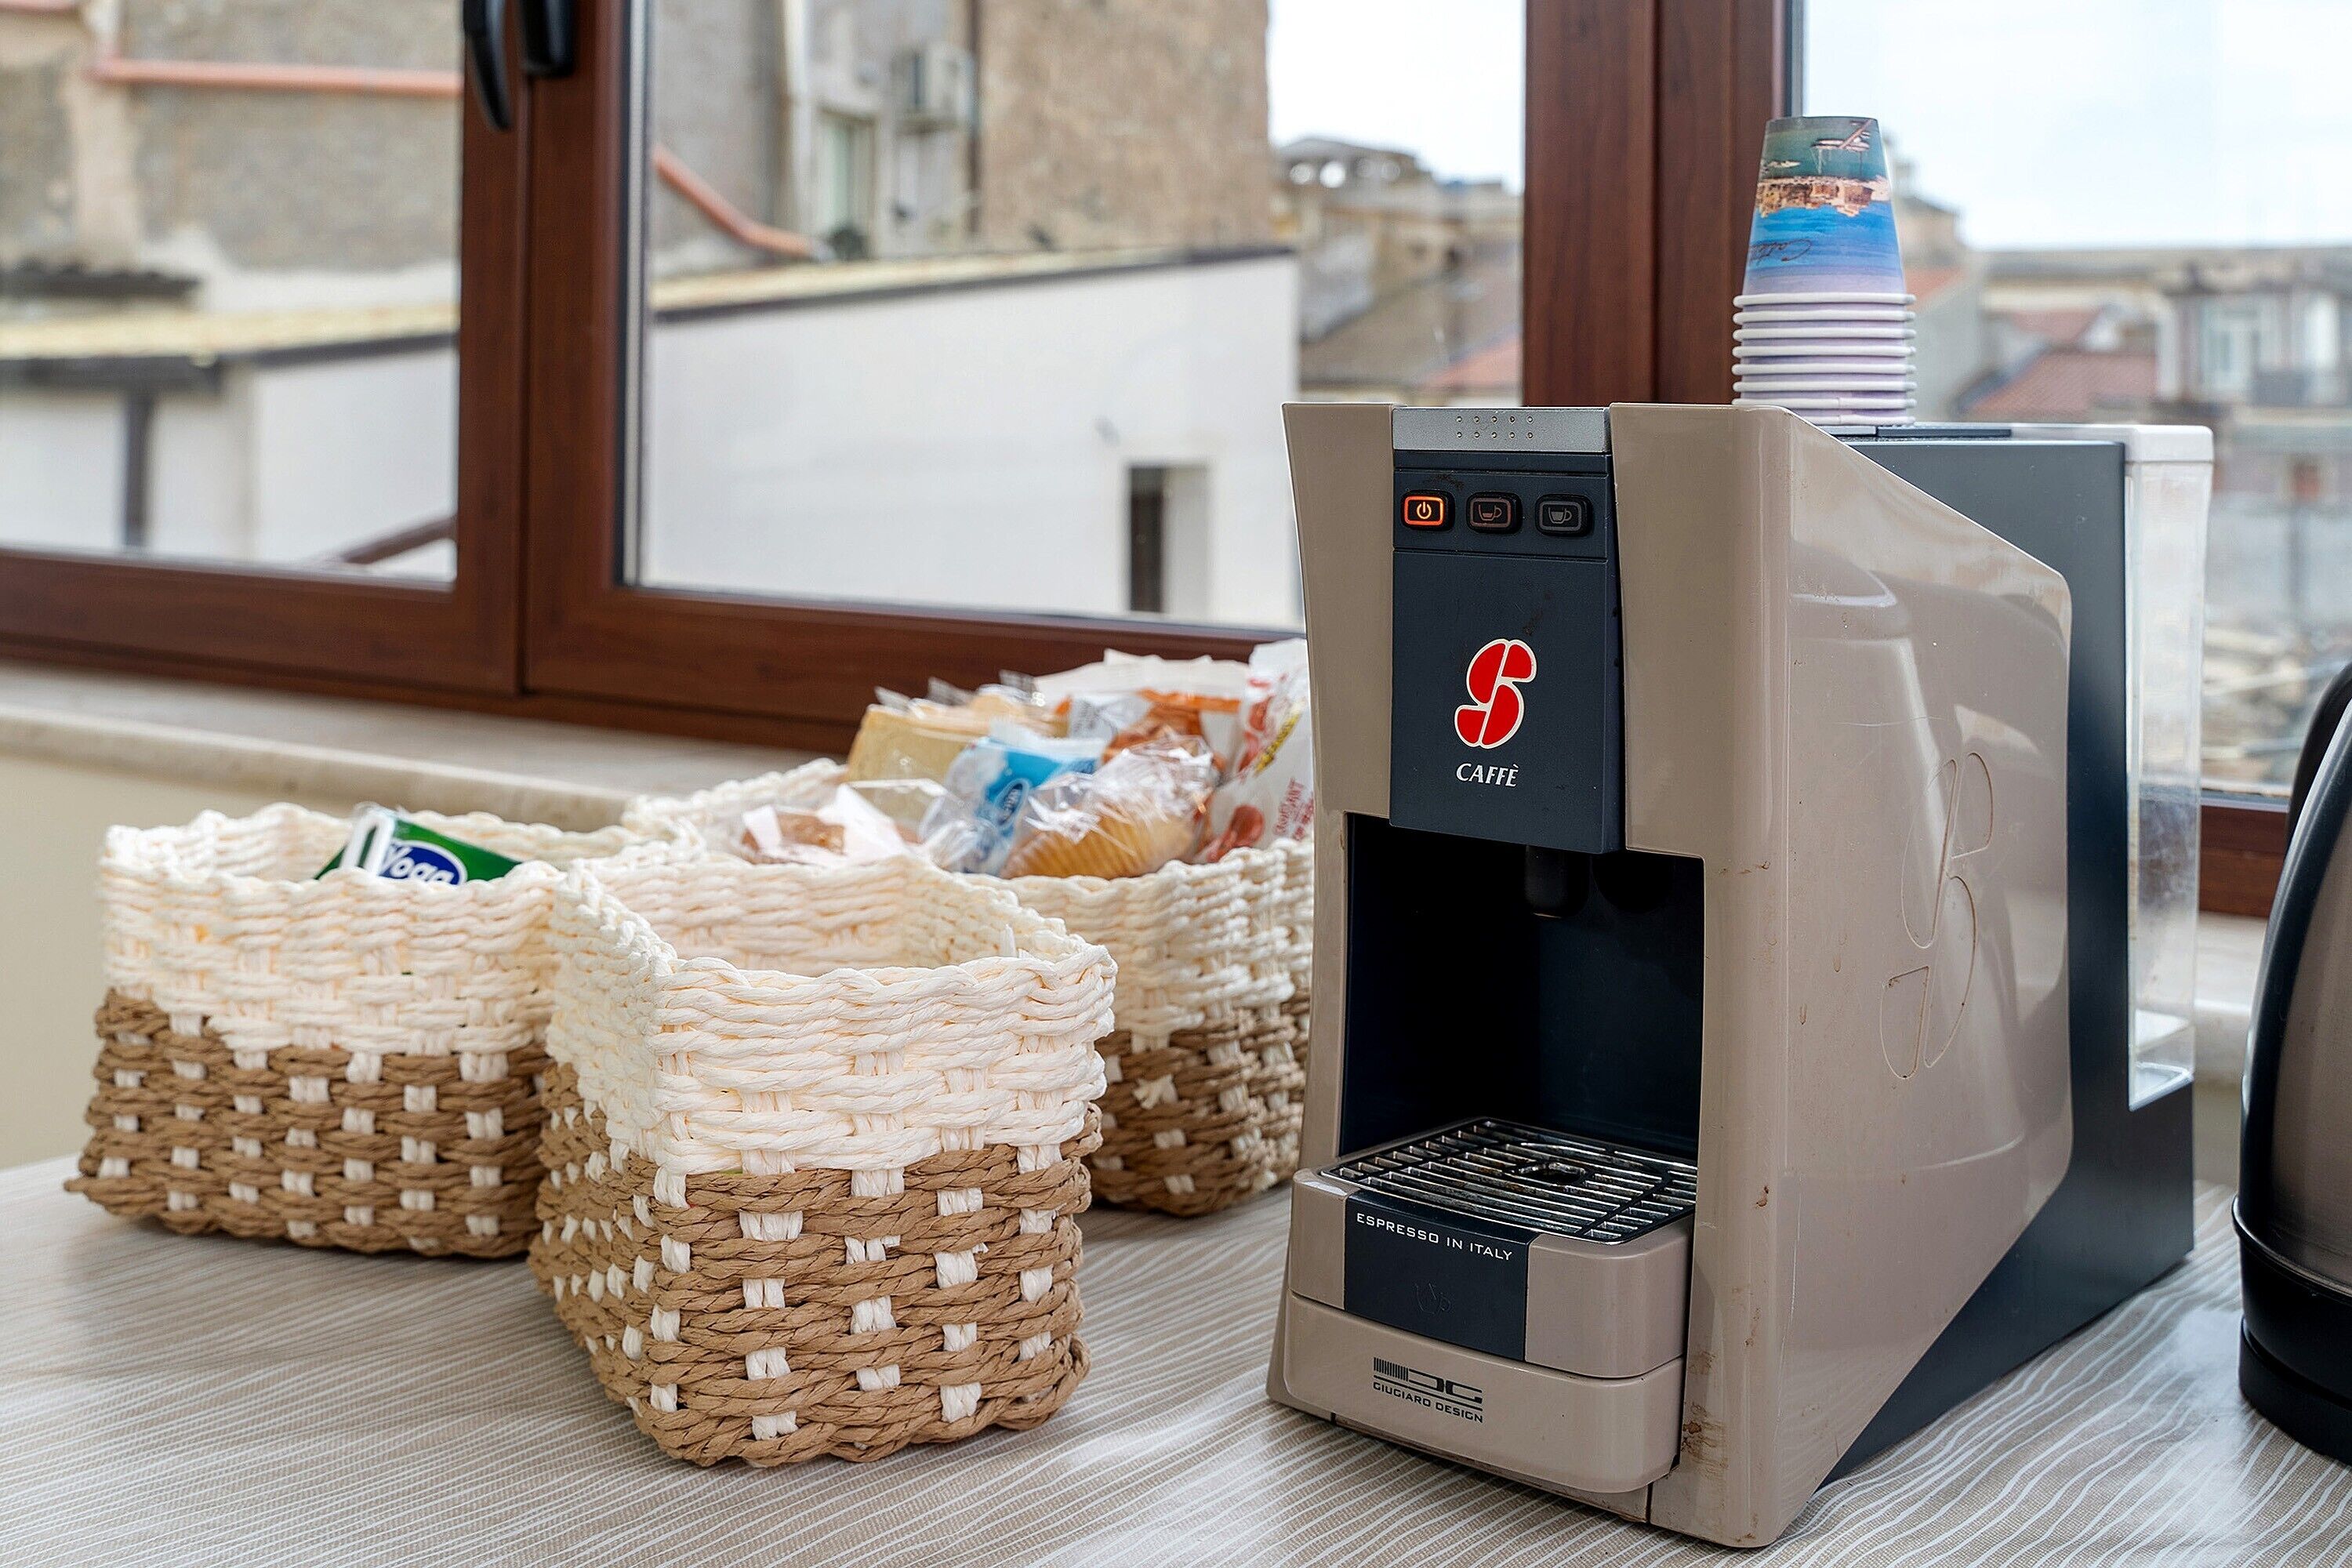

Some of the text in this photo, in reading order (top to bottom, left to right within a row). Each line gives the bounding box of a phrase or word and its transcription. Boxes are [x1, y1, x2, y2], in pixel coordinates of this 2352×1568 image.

[1456, 763, 1519, 787] CAFFÈ
[1356, 1213, 1512, 1261] ESPRESSO IN ITALY
[1373, 1381, 1483, 1423] GIUGIARO DESIGN
